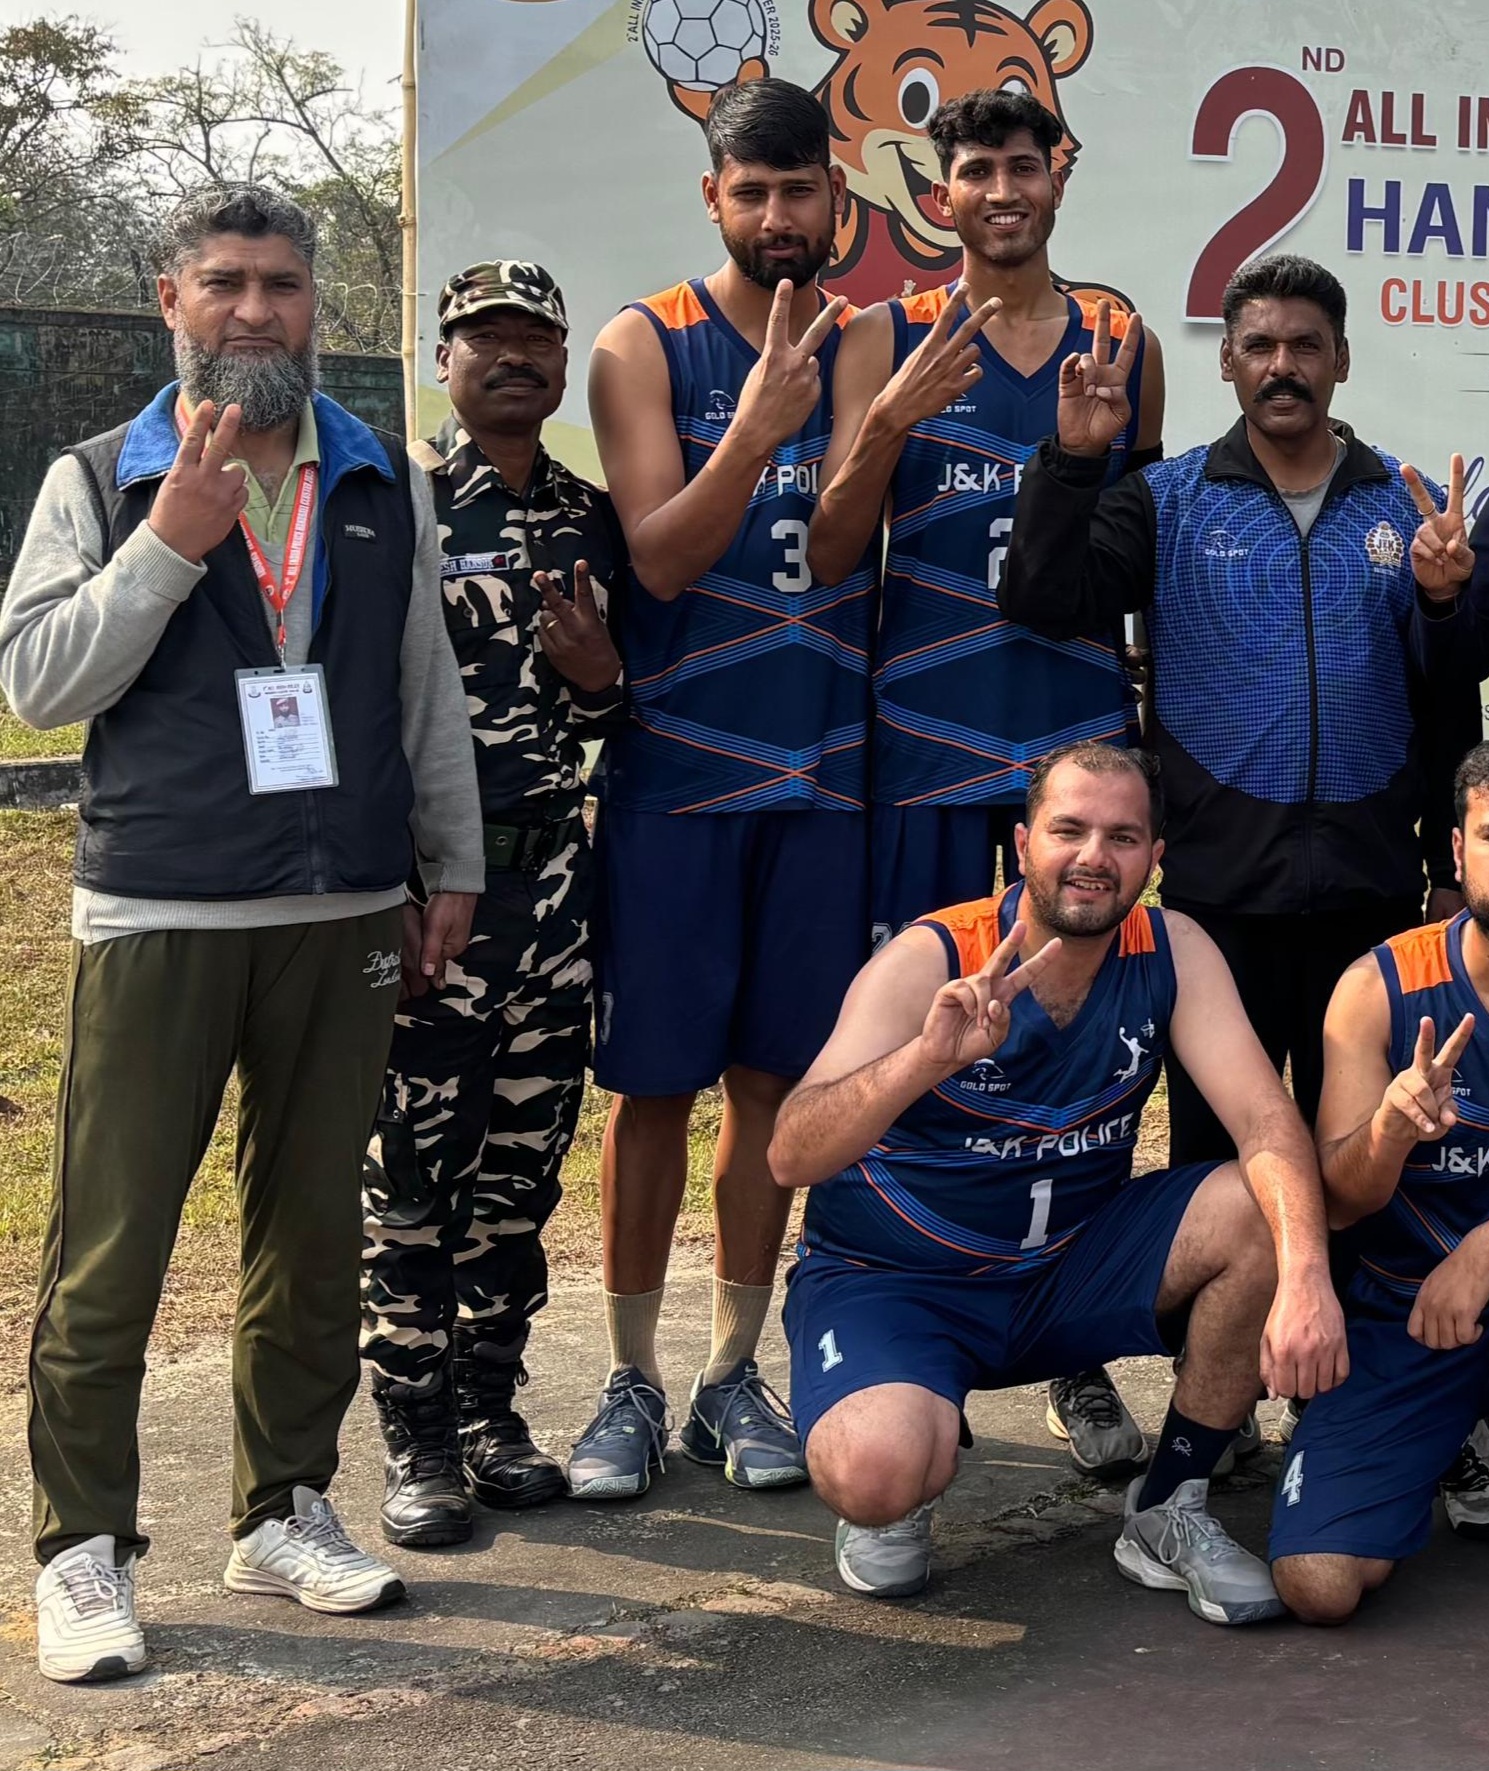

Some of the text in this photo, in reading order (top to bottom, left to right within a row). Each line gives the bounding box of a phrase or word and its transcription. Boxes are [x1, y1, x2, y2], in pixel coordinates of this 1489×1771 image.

[1302, 47, 1345, 72] ND
[1342, 90, 1436, 146] ALL
[954, 405, 977, 413] SPOT
[938, 463, 1000, 494] J&K
[771, 519, 812, 593] 3
[1228, 548, 1249, 557] SPOT
[960, 1081, 1011, 1092] GOLD SPOT
[1036, 1112, 1134, 1161] POLICE
[1020, 1179, 1053, 1250] 1
[818, 1329, 843, 1373] 1
[1281, 1450, 1305, 1507] 4
